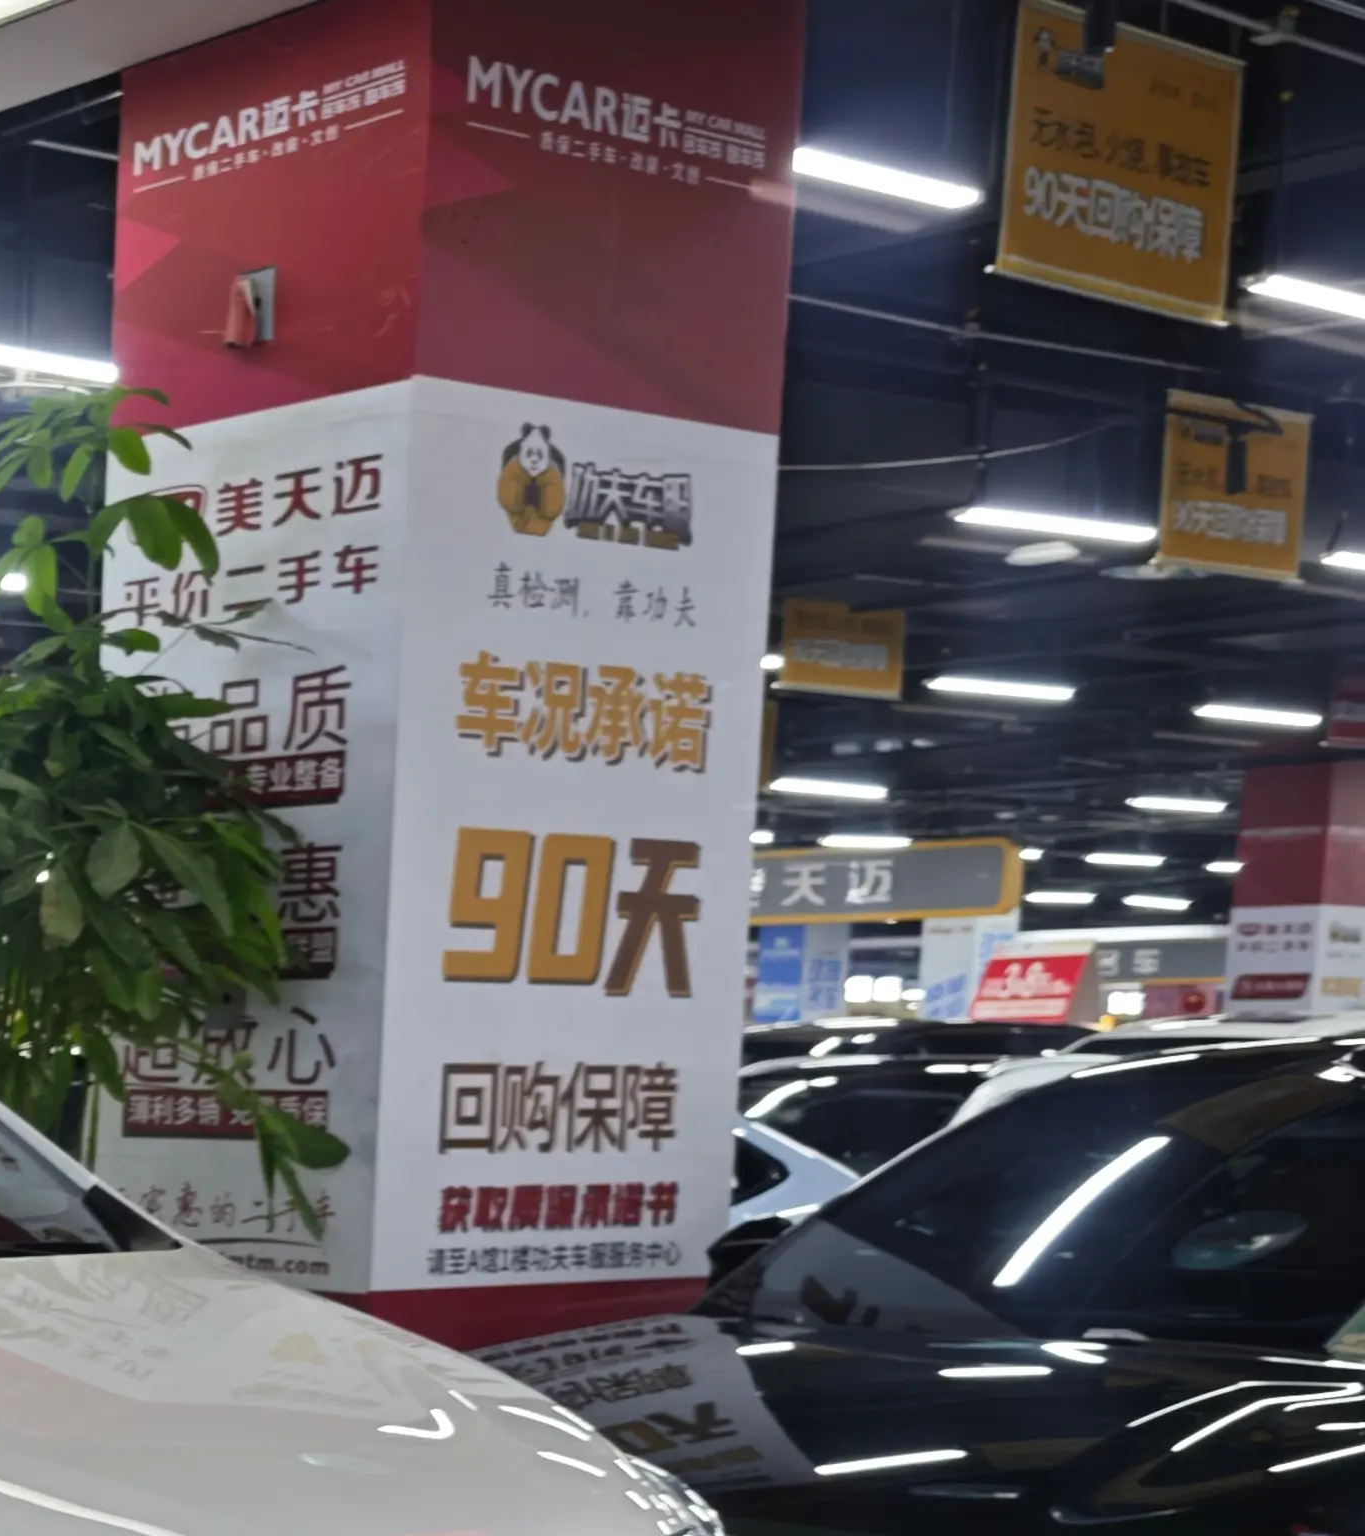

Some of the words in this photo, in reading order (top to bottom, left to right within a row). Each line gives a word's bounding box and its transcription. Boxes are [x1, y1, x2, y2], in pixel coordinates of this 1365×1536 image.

[1023, 166, 1205, 265] 90天回购保障
[216, 453, 384, 538] 美天迈
[123, 544, 380, 629] 平价二手车
[169, 664, 353, 755] 品质
[455, 650, 714, 774] 车况承诺
[245, 756, 345, 795] 专业整备
[442, 825, 702, 998] 90天
[437, 1061, 681, 1155] 回购保障
